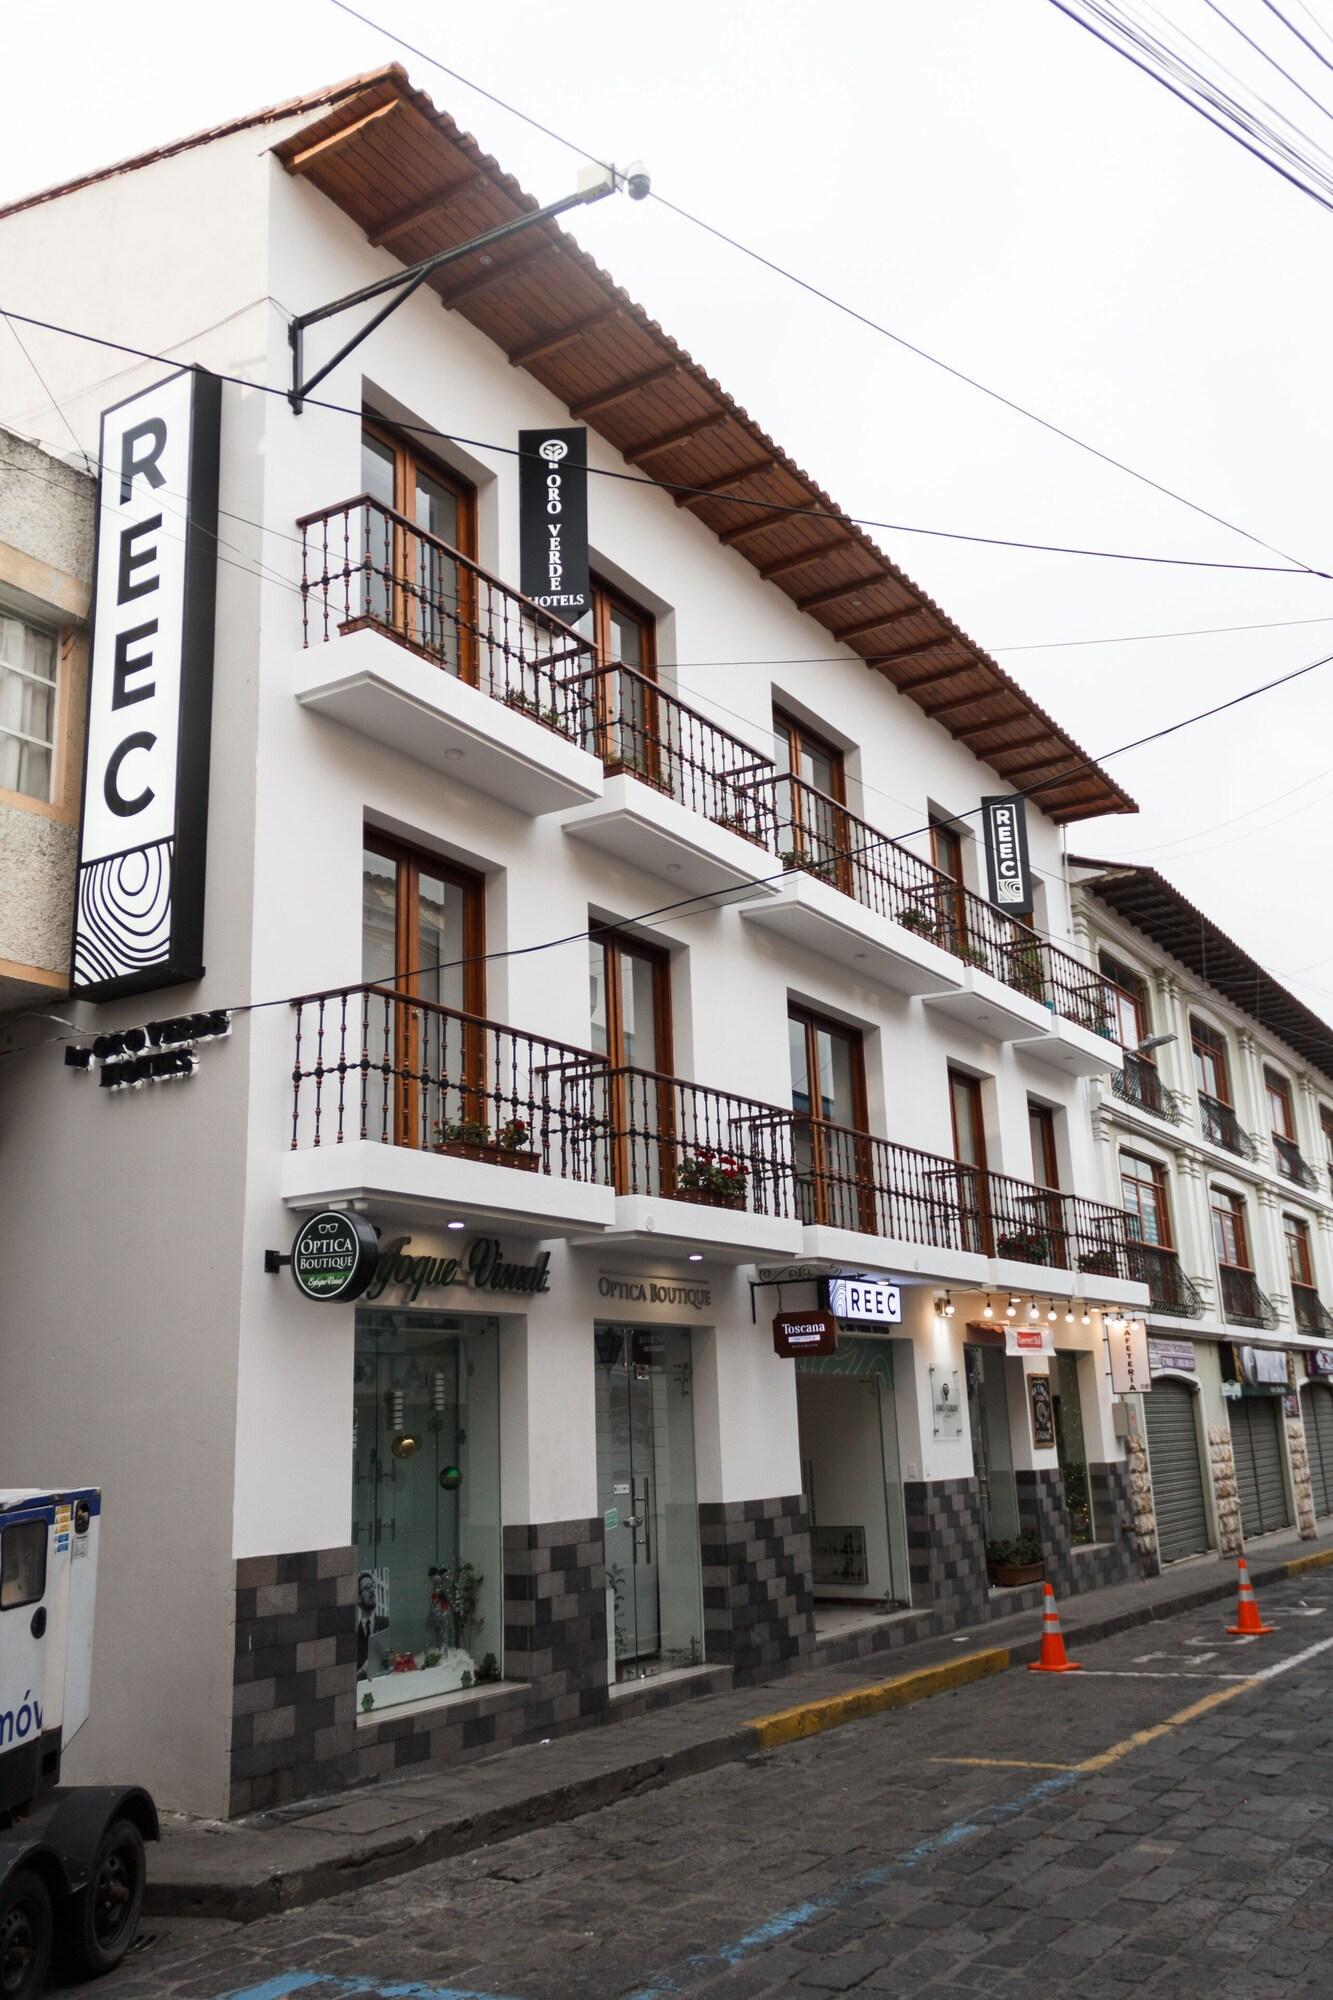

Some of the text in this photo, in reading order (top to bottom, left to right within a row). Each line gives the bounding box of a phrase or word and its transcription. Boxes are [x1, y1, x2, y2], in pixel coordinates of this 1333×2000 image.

[546, 474, 563, 591] ORO VERDE
[104, 416, 168, 818] REEC
[995, 809, 1016, 877] REEC
[300, 1235, 353, 1255] ÓPTICA
[300, 1256, 353, 1270] BOUTIQUE
[649, 1283, 712, 1311] BOUTIQUE
[850, 1287, 897, 1315] REEC
[781, 1322, 826, 1335] Toscana
